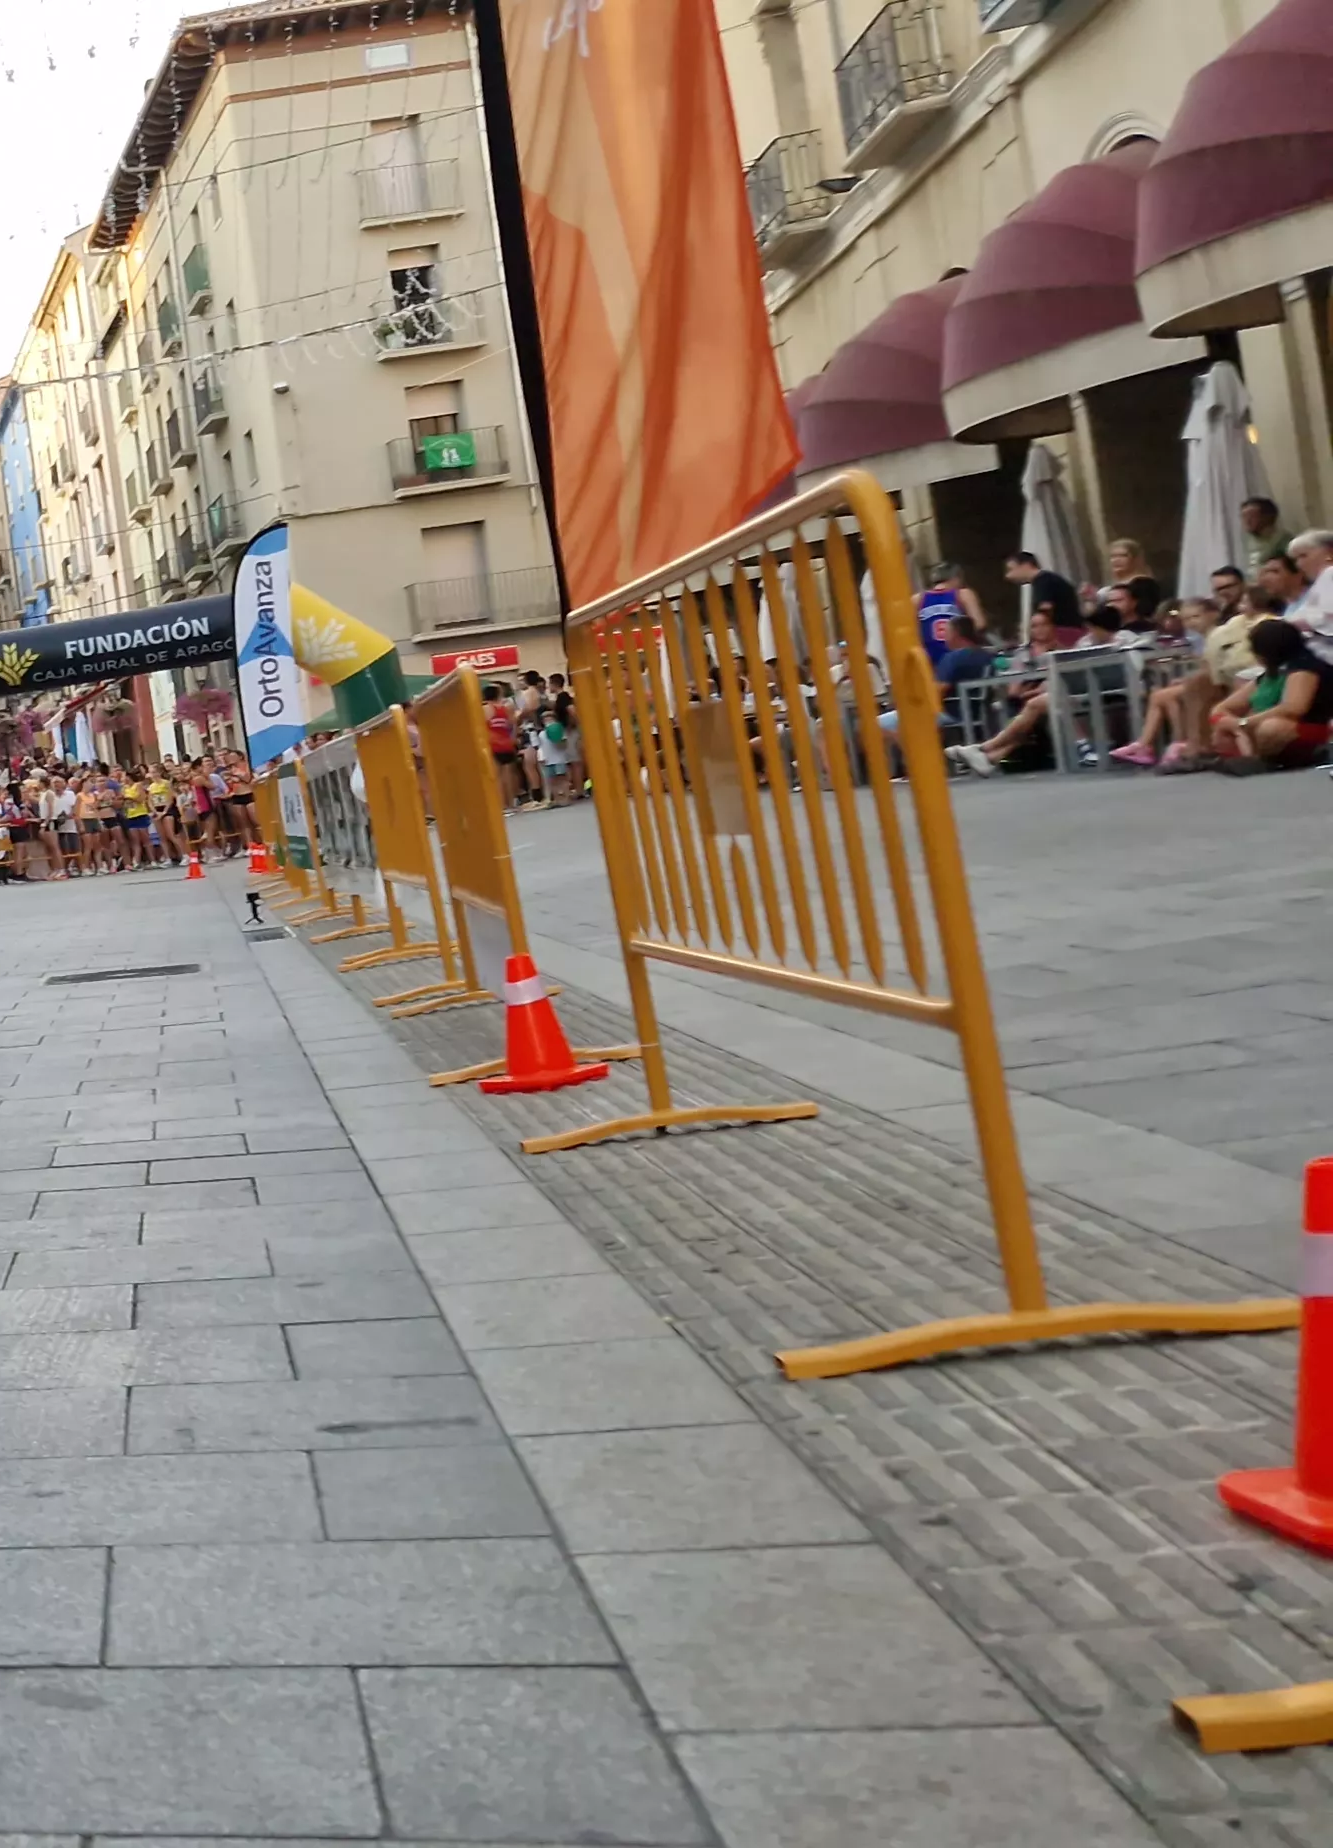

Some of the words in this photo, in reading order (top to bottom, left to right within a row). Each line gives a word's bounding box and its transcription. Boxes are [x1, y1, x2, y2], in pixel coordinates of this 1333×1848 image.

[32, 666, 77, 683] CAJA
[83, 657, 140, 675] RURAL
[145, 650, 169, 665] DE
[175, 637, 233, 659] ARAGÓ
[64, 616, 210, 659] FUNDACIÓN
[253, 560, 285, 718] OrtoAvanza
